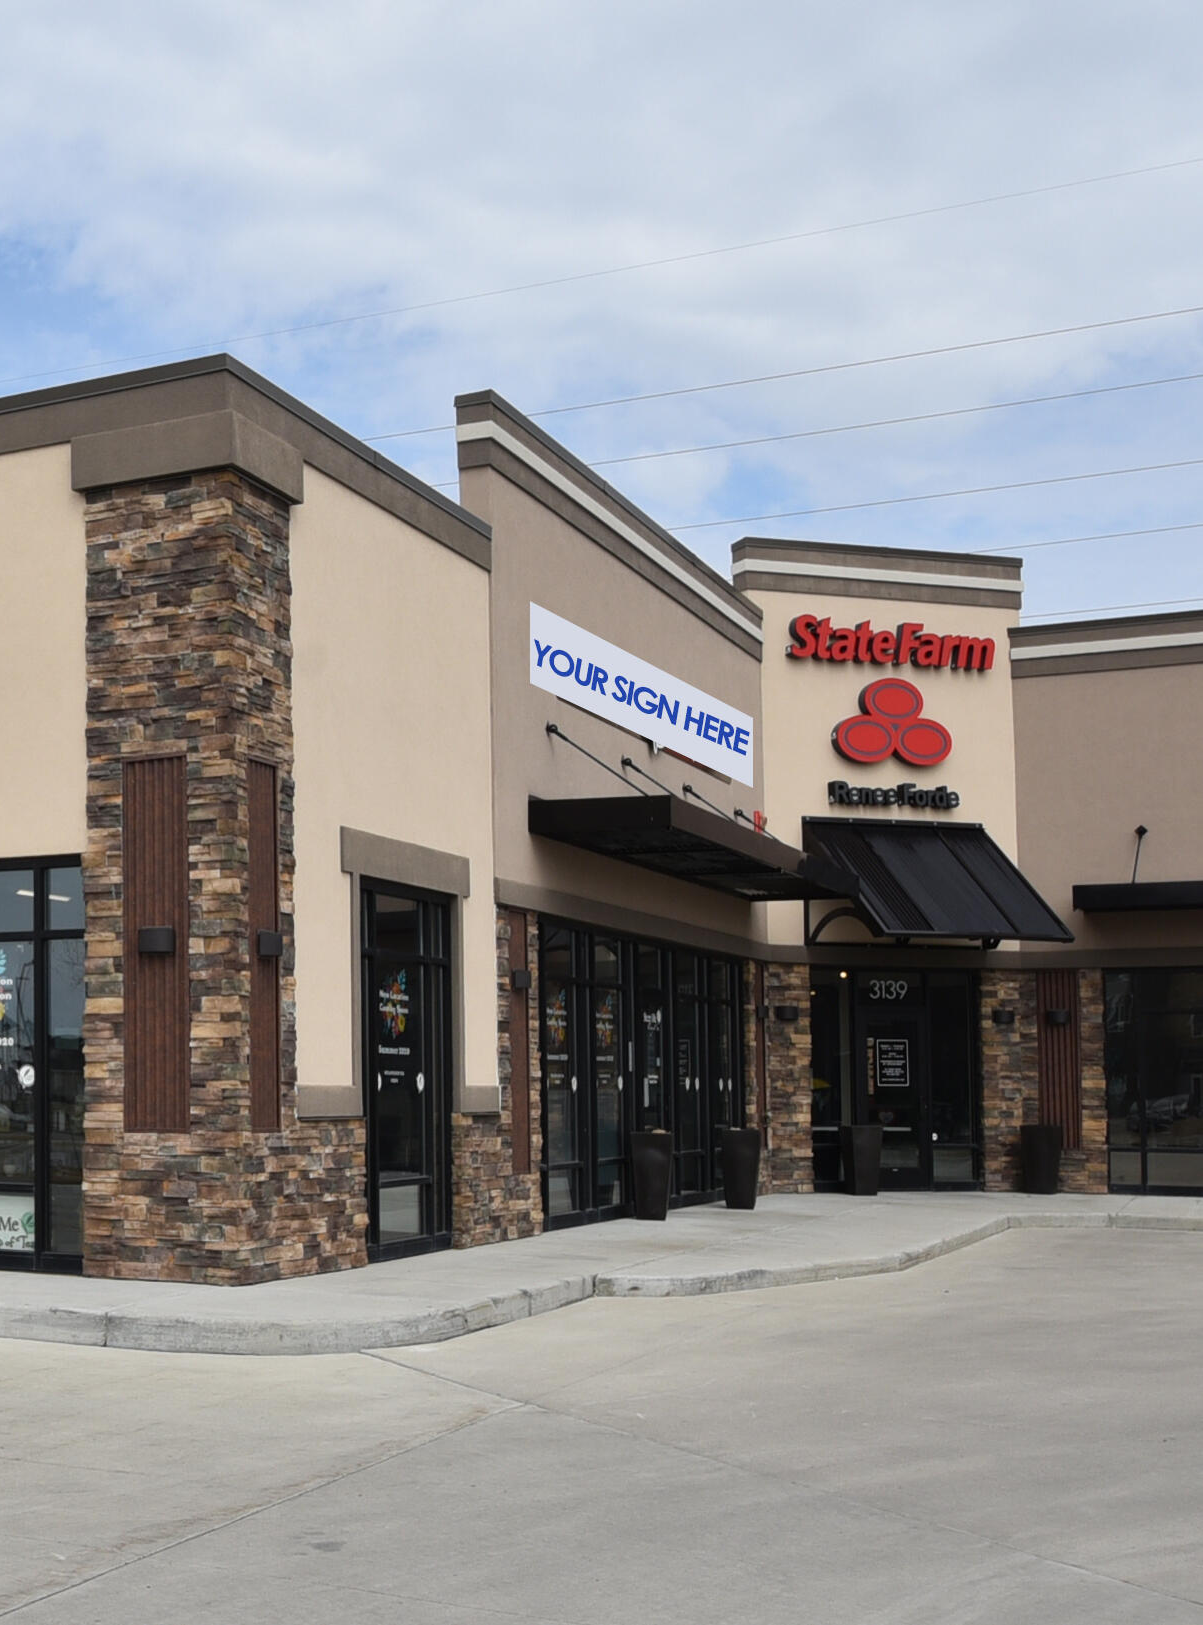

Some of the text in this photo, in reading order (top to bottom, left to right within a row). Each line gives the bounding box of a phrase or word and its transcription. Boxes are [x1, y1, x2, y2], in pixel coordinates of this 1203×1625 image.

[786, 613, 995, 671] State Farm
[533, 638, 750, 756] YOUR SIGN HERE
[828, 780, 960, 809] Renee Forde
[869, 980, 908, 999] 3139
[4, 1236, 15, 1248] of
